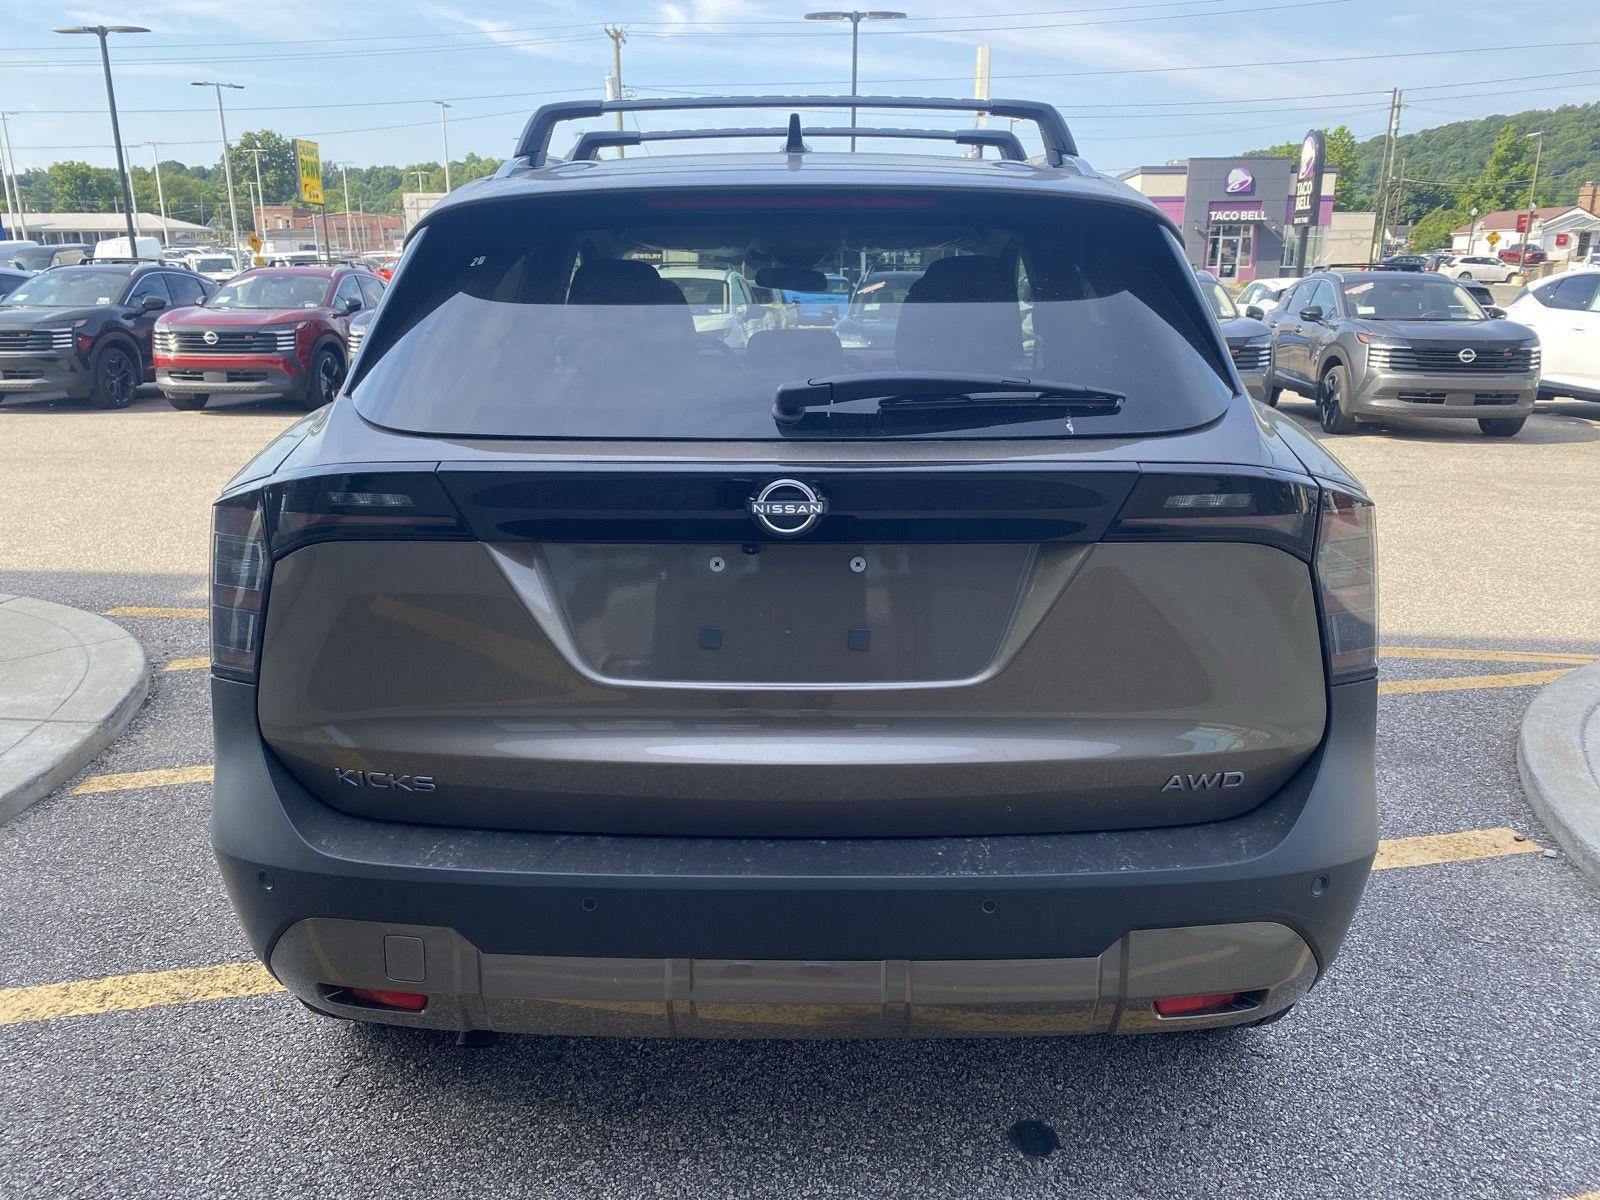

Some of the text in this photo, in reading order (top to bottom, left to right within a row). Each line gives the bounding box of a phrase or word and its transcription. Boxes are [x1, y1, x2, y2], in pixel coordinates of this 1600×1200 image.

[300, 158, 320, 180] PAWN
[1297, 181, 1312, 196] TACO
[1296, 196, 1311, 210] BELL
[1209, 211, 1268, 221] TACO BELL
[753, 504, 821, 514] NISSAN
[334, 767, 436, 792] KICKS
[1160, 771, 1245, 793] AWD
